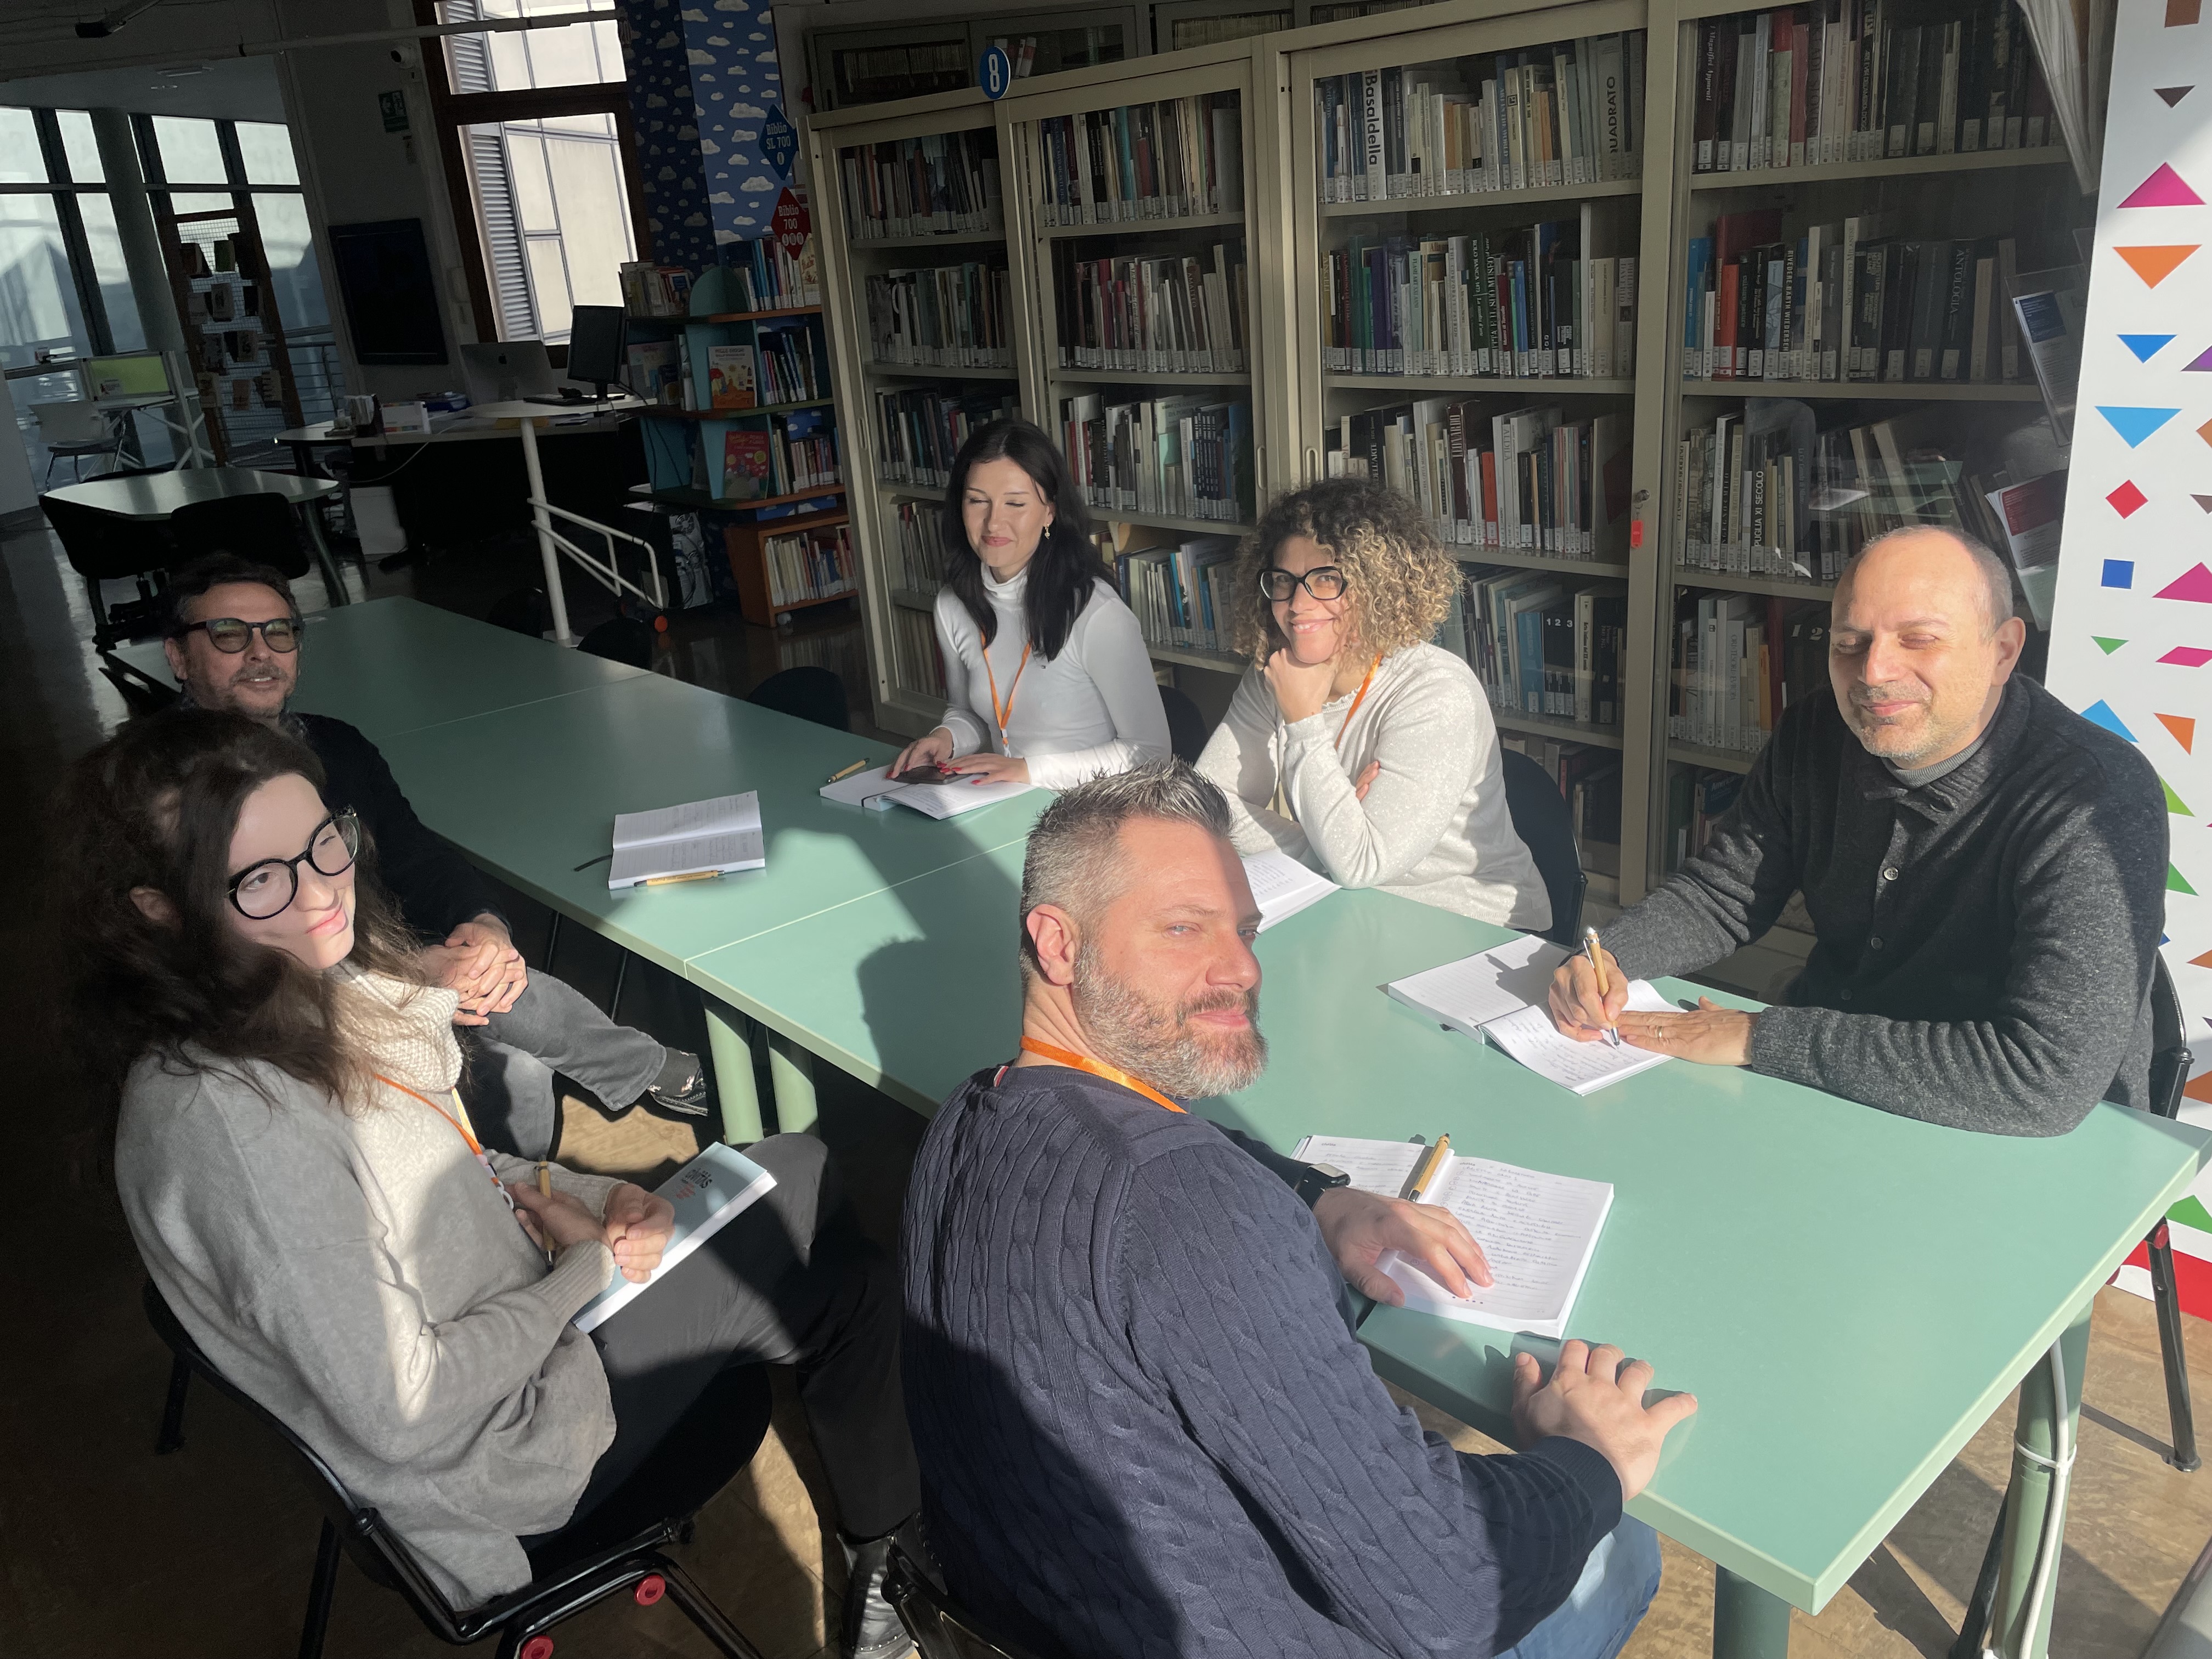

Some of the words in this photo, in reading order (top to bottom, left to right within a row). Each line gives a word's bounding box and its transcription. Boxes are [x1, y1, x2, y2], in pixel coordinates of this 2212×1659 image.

[989, 54, 1000, 92] 8
[766, 122, 787, 135] Biblio
[1365, 75, 1381, 165] Basaldella
[766, 138, 776, 150] SL
[777, 136, 791, 148] 700
[778, 205, 799, 216] Biblio
[783, 218, 798, 229] 700
[1487, 256, 1496, 287] MUSEO
[1950, 249, 1964, 314] ANTOLOGIA
[1756, 471, 1764, 504] SECOLO
[1754, 518, 1763, 546] PUGLIA
[1566, 619, 1573, 628] 3
